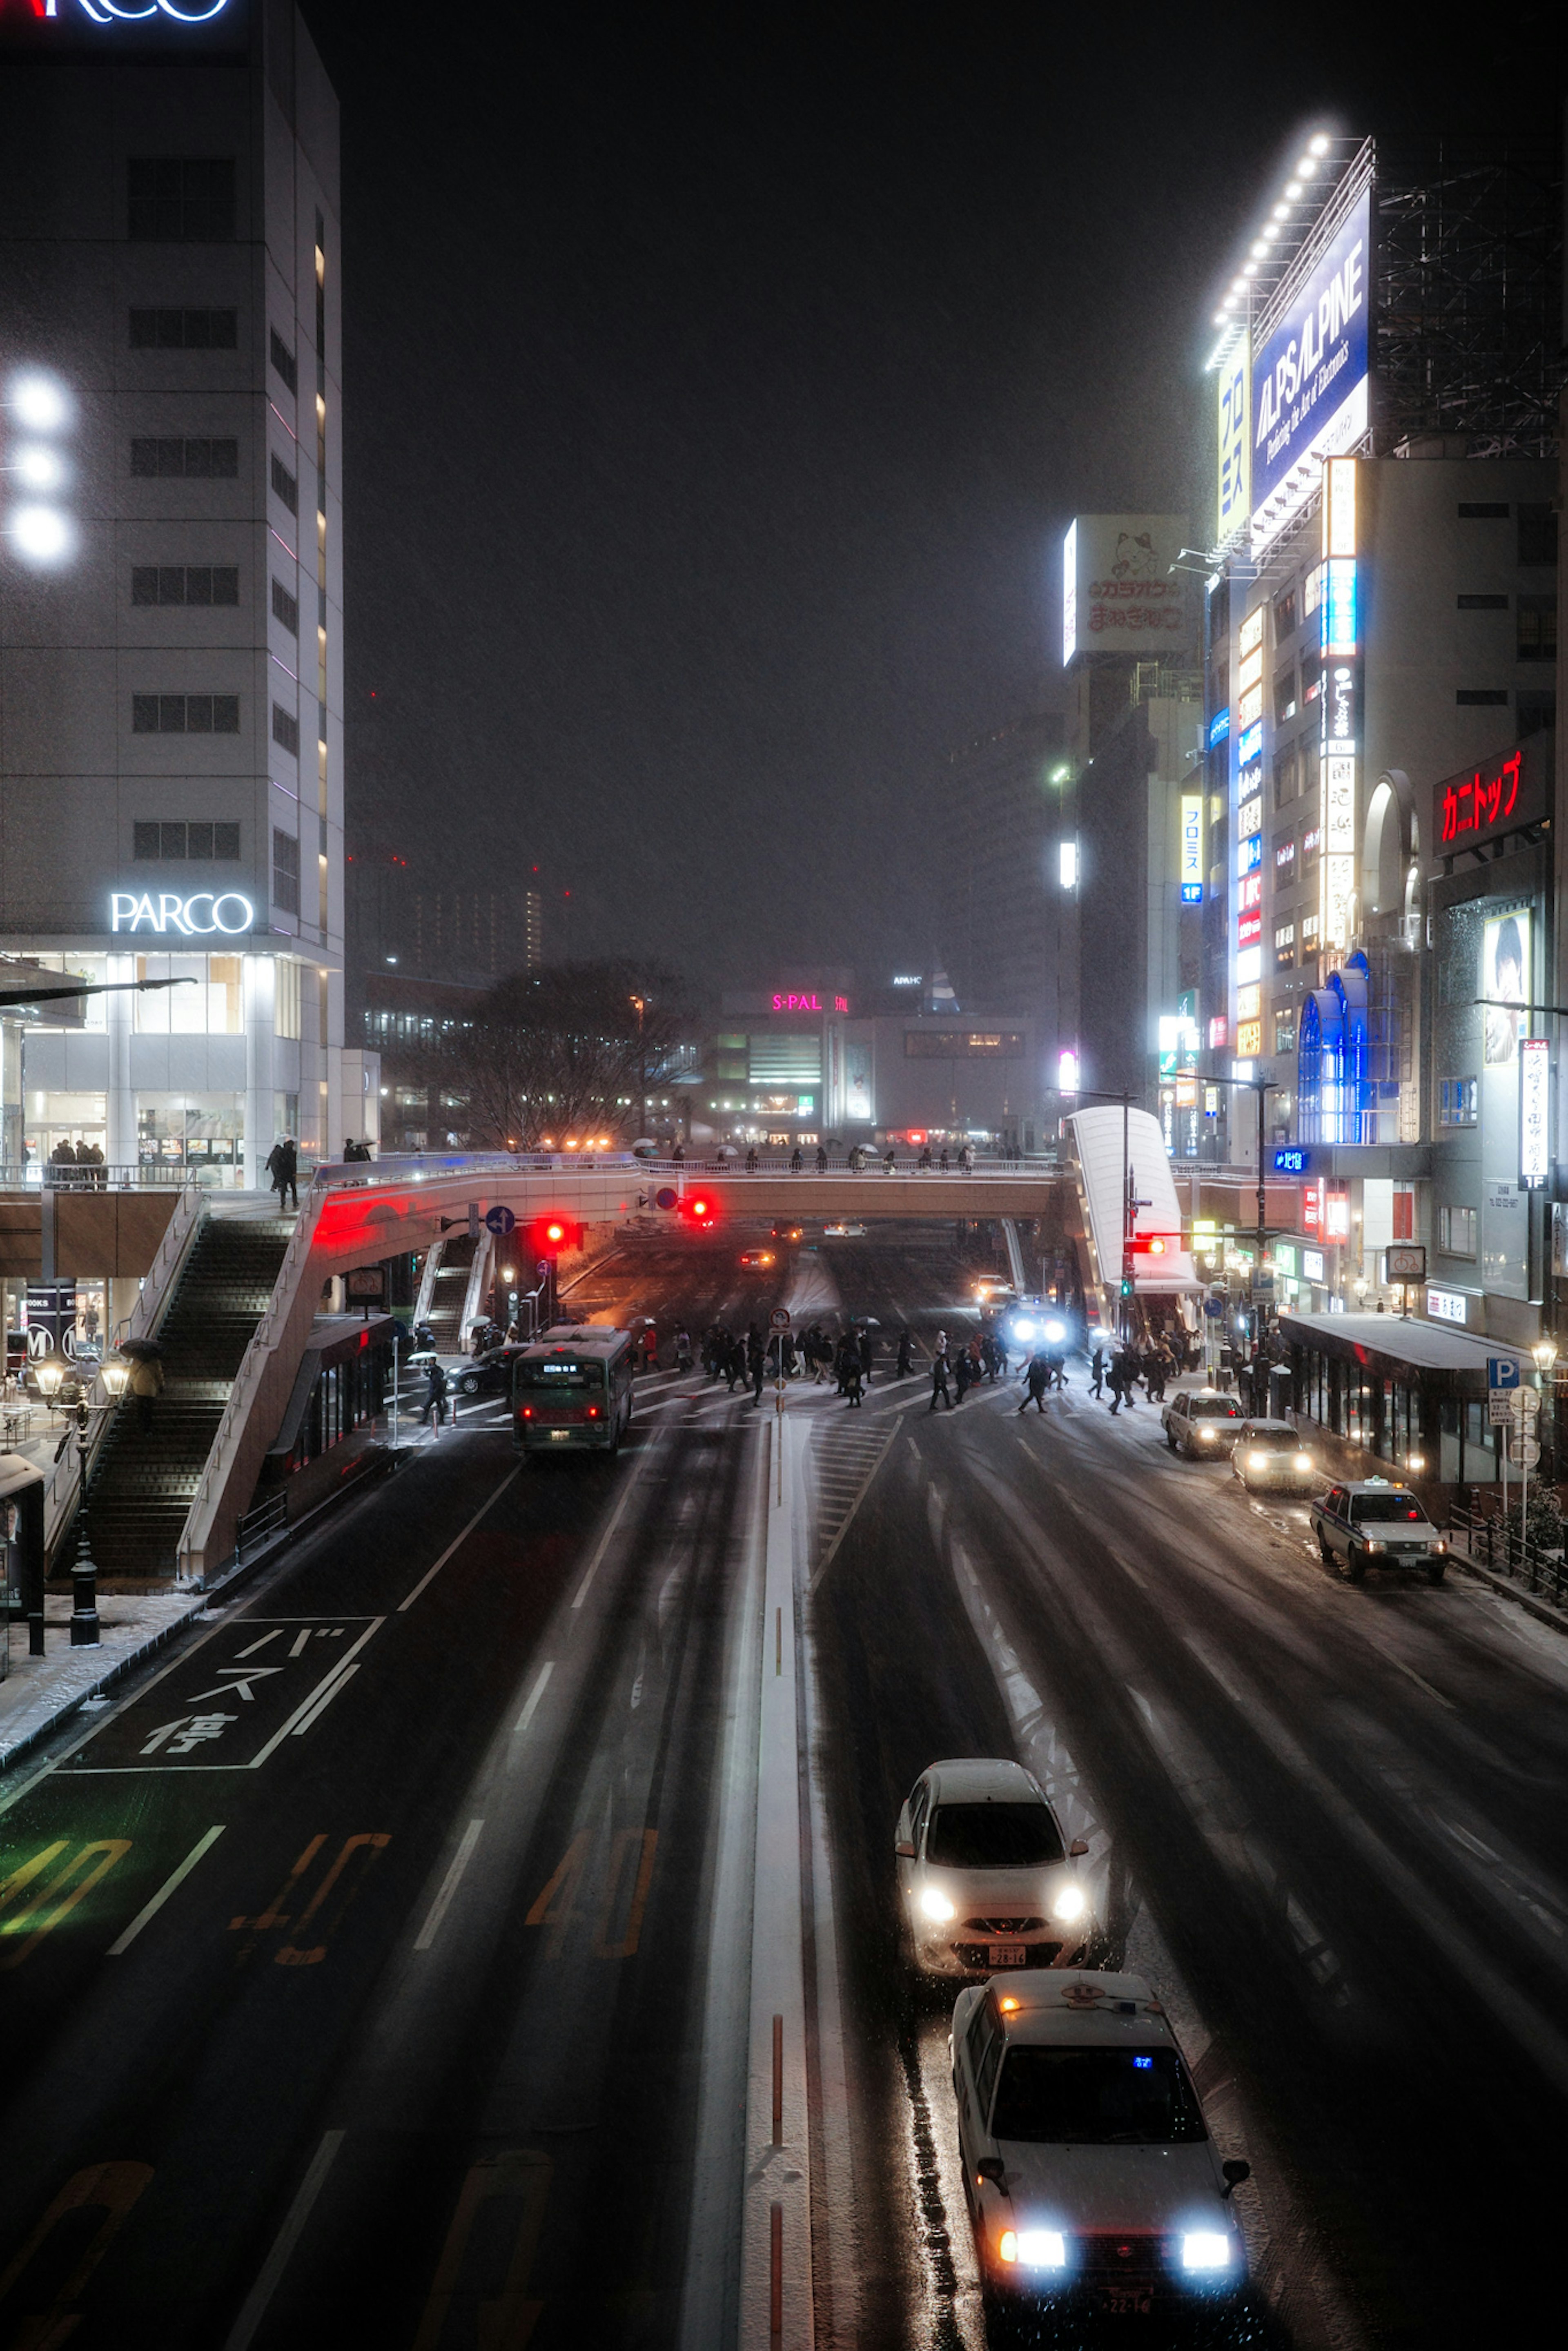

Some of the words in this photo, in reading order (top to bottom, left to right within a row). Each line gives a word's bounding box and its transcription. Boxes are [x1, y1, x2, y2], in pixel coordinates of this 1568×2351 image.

[1267, 420, 1290, 464] Perfecting
[1291, 406, 1299, 432] the
[1300, 390, 1310, 421] Art
[1319, 339, 1349, 396] Electronics
[1442, 750, 1522, 842] カニトップ
[1183, 887, 1201, 900] 1F
[110, 892, 254, 935] PARCO
[773, 994, 822, 1010] S-PAL
[1526, 1177, 1544, 1188] 1F
[1496, 1360, 1515, 1386] P
[524, 1828, 659, 1959] 40
[997, 1954, 1024, 1963] 28-16
